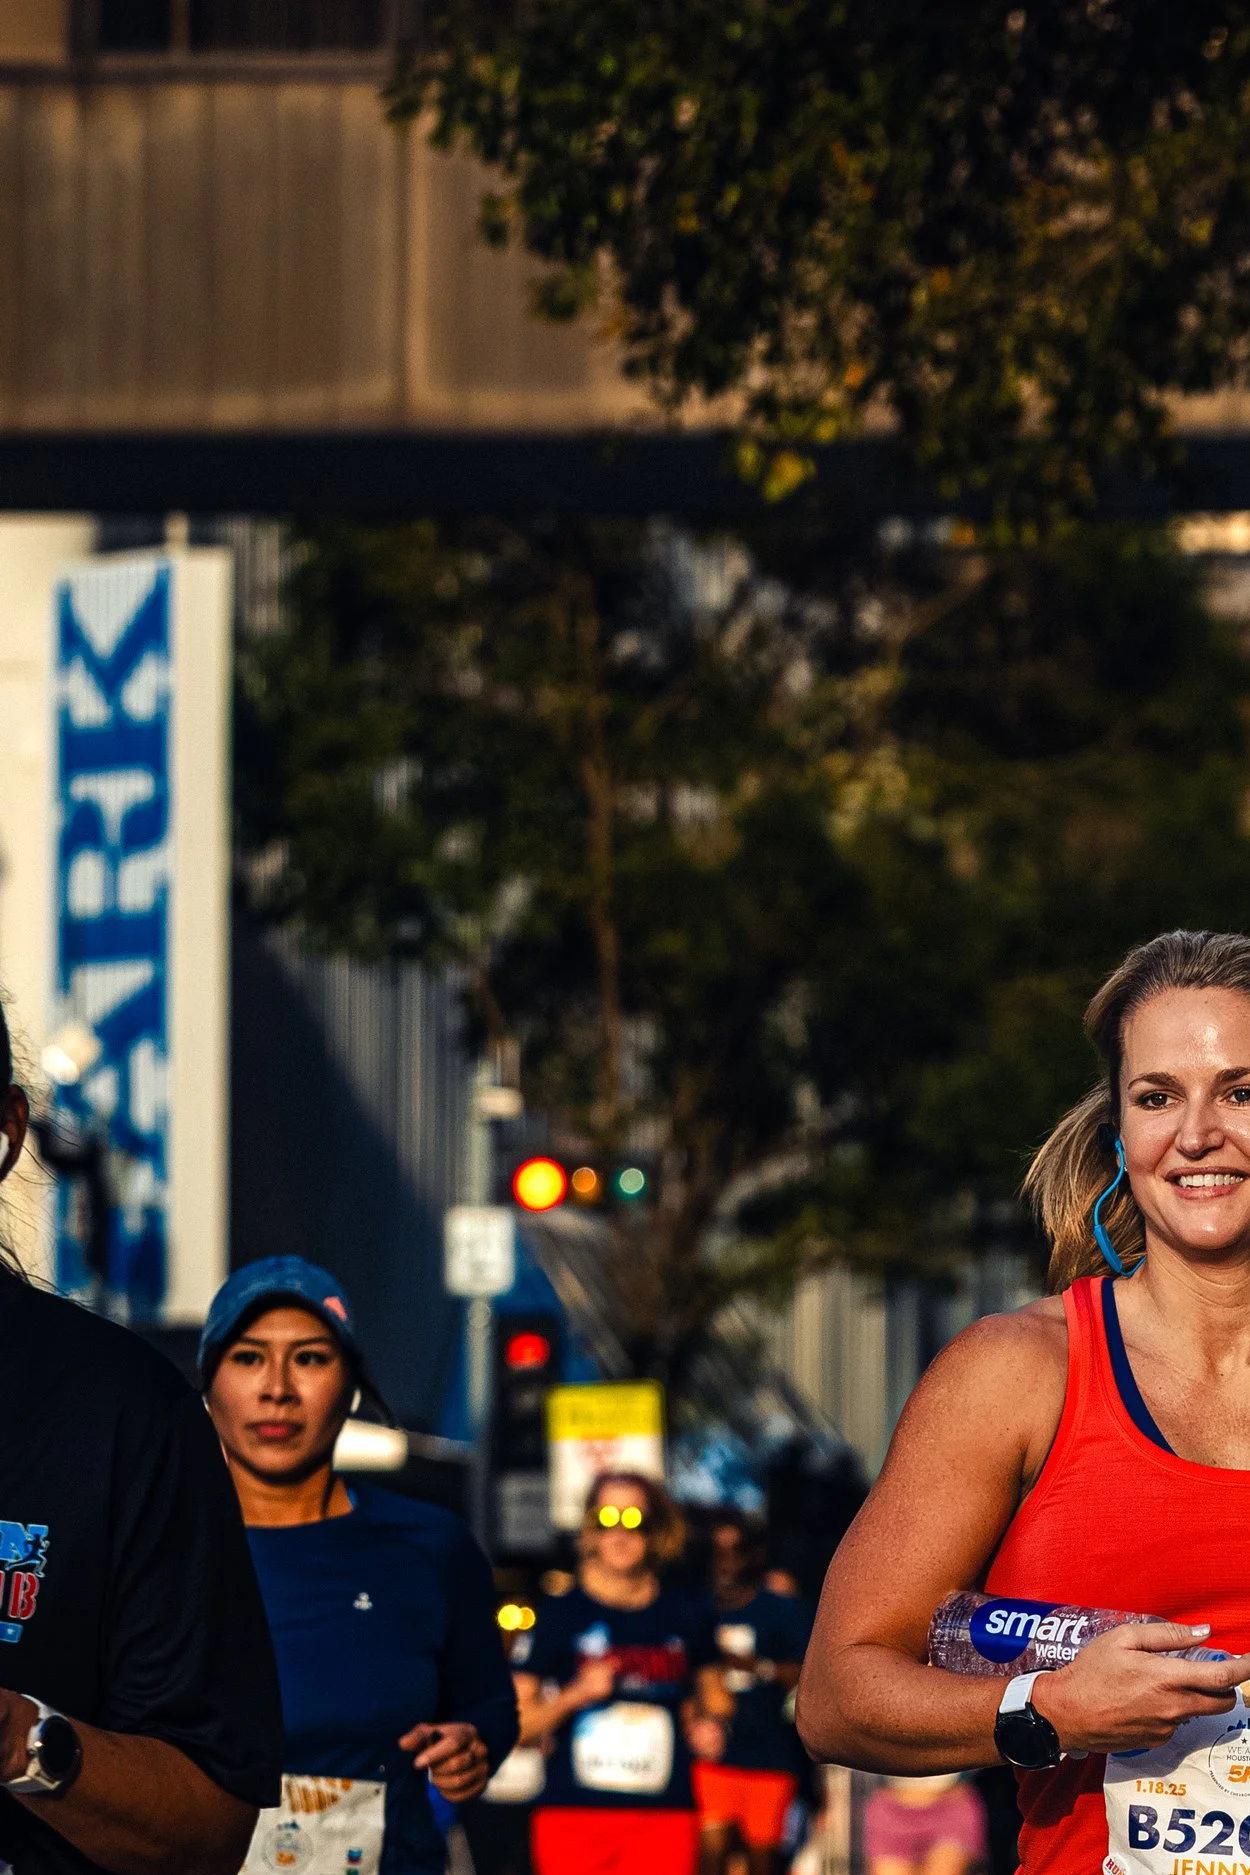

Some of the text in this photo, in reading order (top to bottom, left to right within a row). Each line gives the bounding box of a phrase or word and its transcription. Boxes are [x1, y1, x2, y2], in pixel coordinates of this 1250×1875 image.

[985, 1609, 1089, 1645] smart
[1034, 1643, 1080, 1661] water
[1227, 1746, 1242, 1755] WE
[1135, 1780, 1187, 1797] 1.18.25
